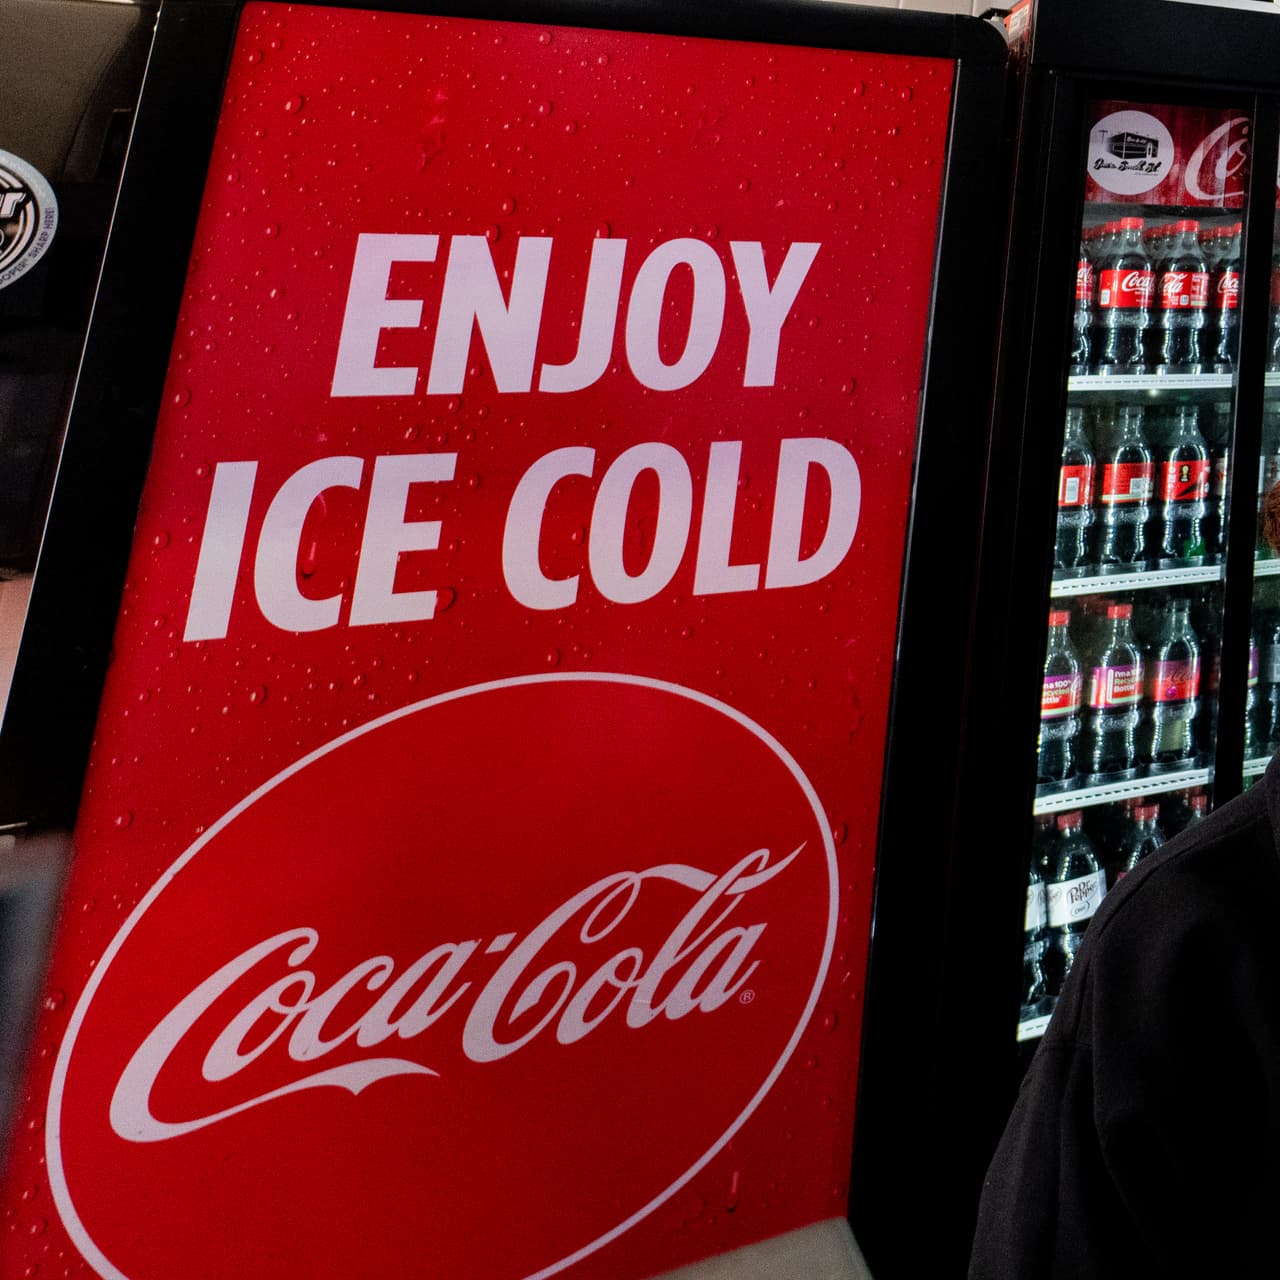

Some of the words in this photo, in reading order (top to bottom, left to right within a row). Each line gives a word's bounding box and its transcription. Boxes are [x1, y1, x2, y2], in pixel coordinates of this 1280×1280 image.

[330, 232, 822, 399] ENJOY
[182, 451, 458, 642] ICE
[501, 436, 864, 611] COLD
[109, 839, 808, 1144] Coca-Cola
